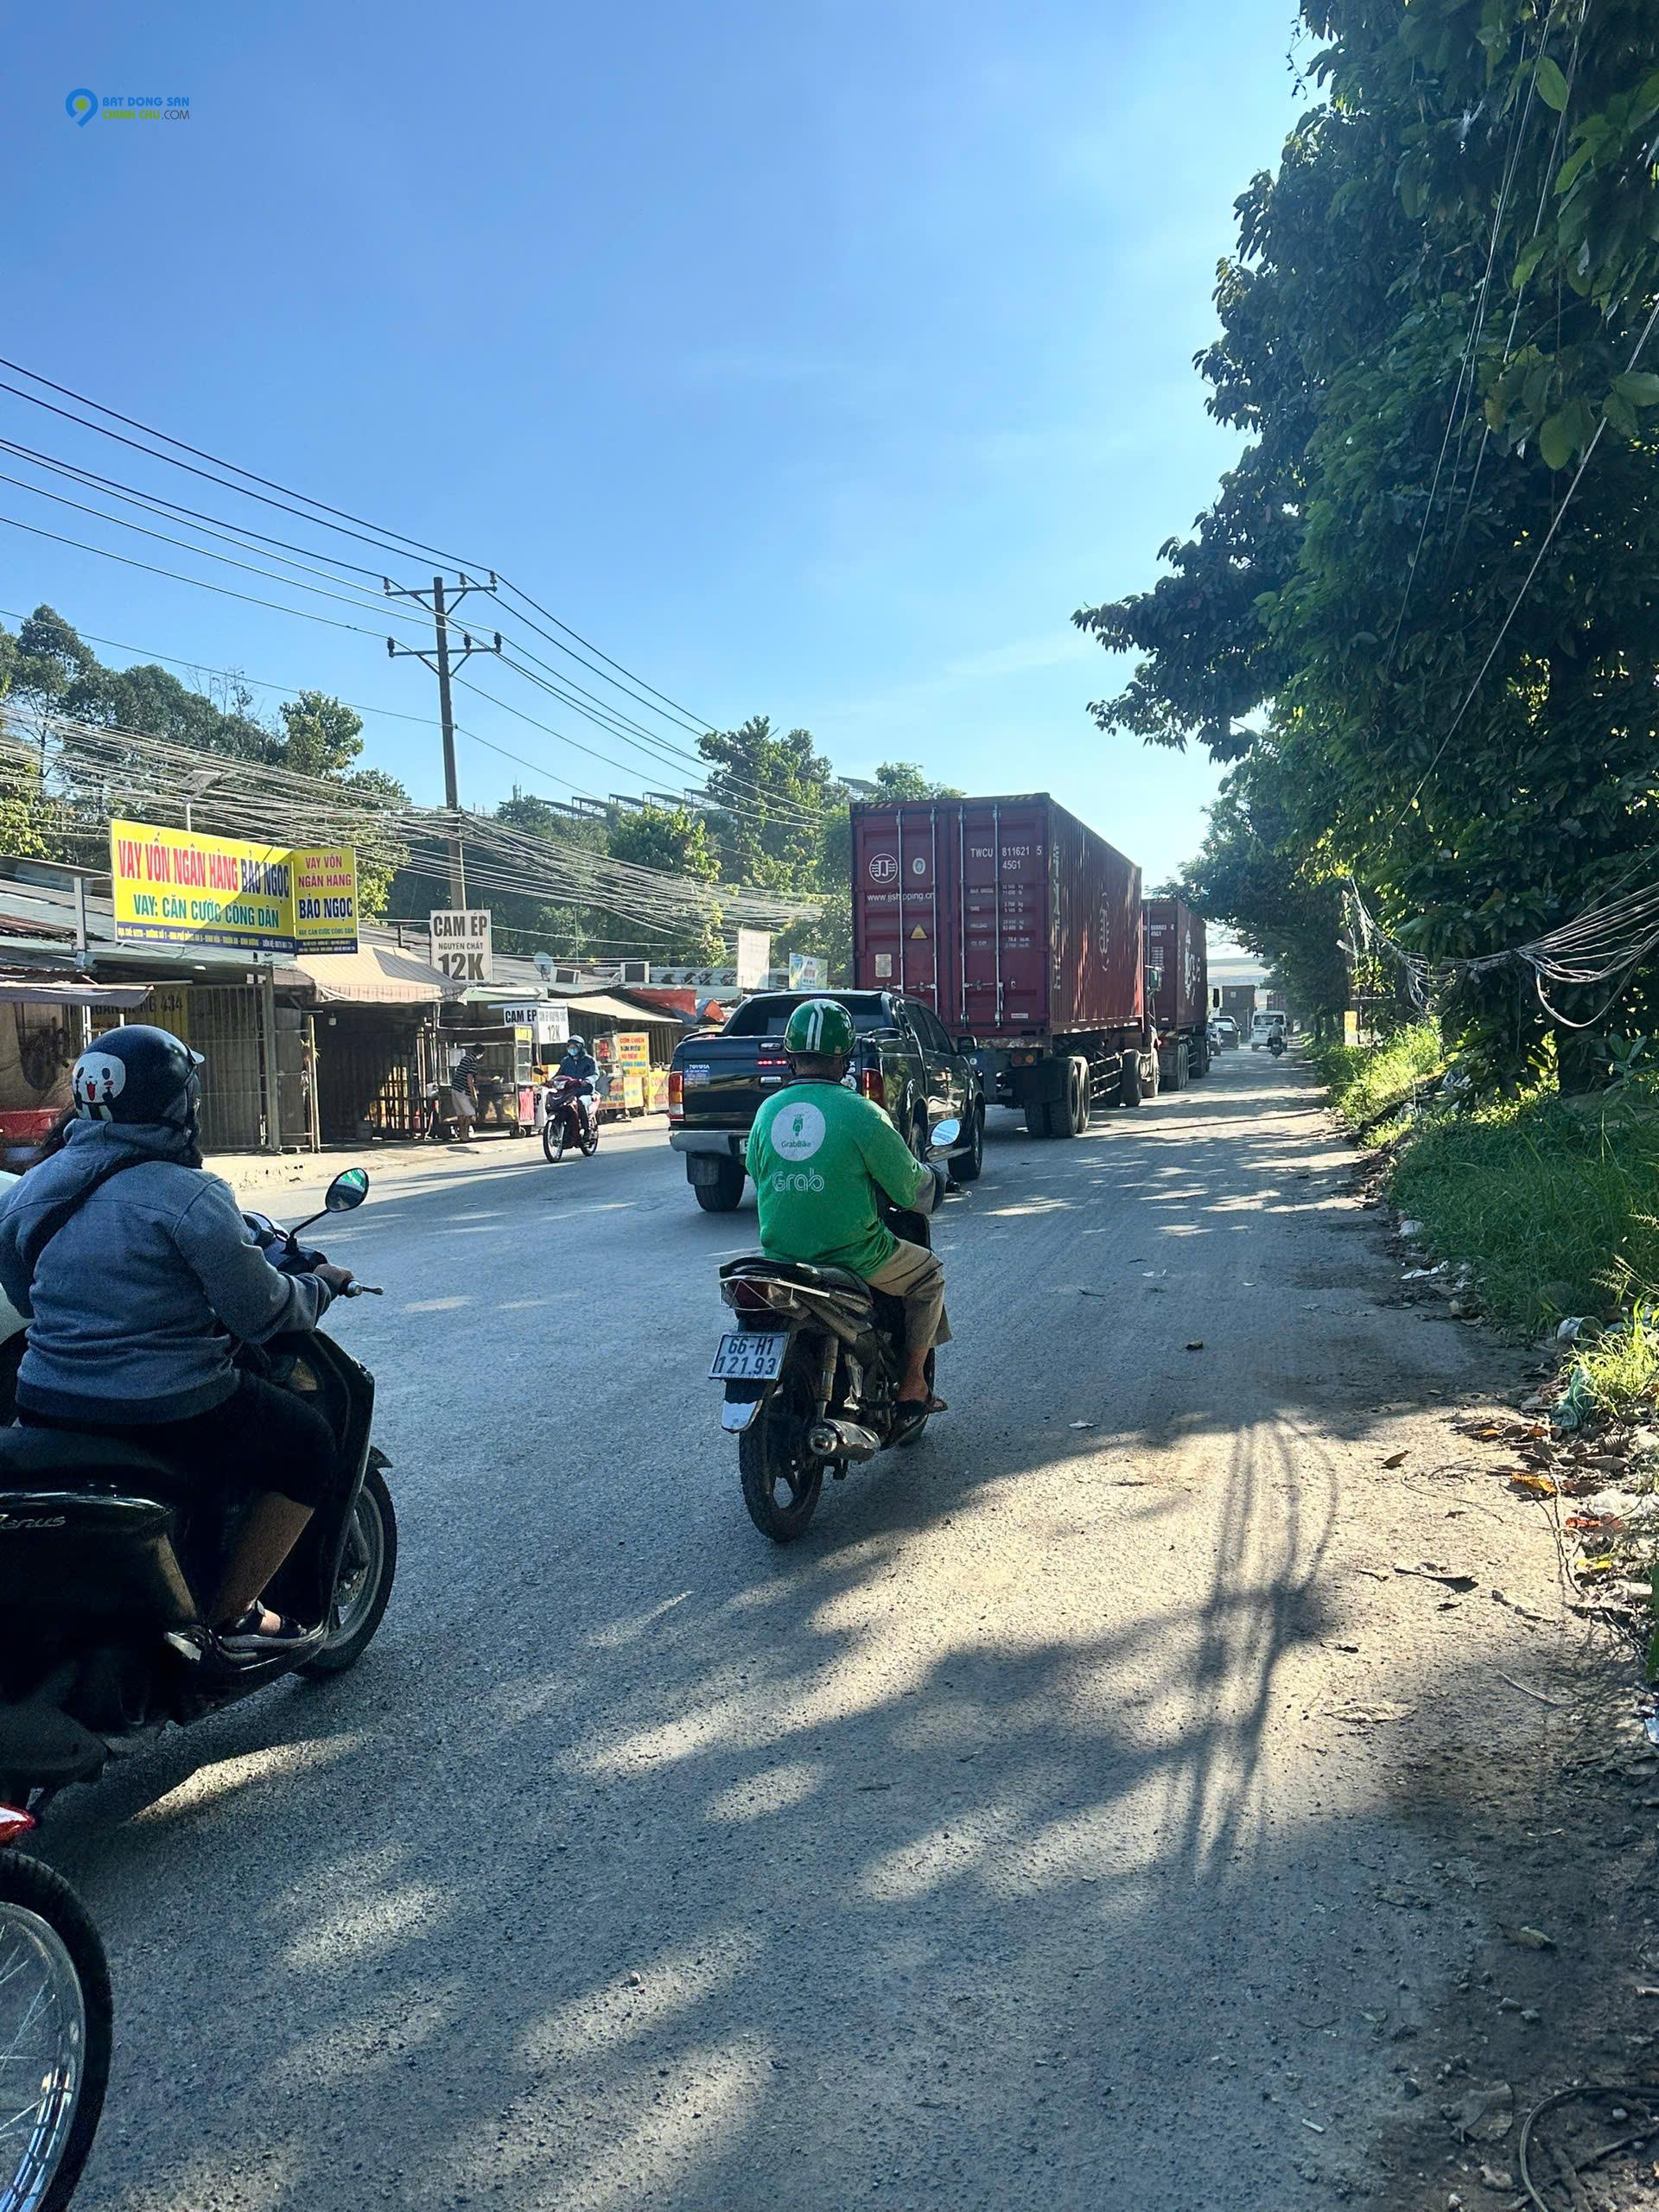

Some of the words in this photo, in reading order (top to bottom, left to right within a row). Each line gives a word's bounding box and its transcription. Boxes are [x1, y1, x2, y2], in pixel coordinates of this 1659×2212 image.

[970, 848, 994, 858] TWCU
[1002, 846, 1030, 857] 811621
[1037, 845, 1042, 855] 5
[118, 840, 142, 879] VAY
[145, 831, 170, 882] VỐN
[173, 843, 206, 887] NGÂN
[209, 849, 238, 891] HÀNG
[241, 850, 260, 894] BẢO
[264, 862, 289, 904] NGỌC
[305, 857, 321, 869] VAY
[1002, 860, 1020, 869] 45G1
[298, 873, 323, 887] NGÂN
[134, 893, 158, 917] VAY:
[162, 894, 187, 918] CĂN
[191, 898, 221, 923] CƯỚC
[226, 901, 254, 925] CÔNG
[258, 905, 279, 928] DÂN
[299, 893, 321, 919] BẢO
[323, 898, 353, 921] NGỌC
[434, 916, 465, 937] CAM
[471, 912, 487, 937] ÉP
[438, 953, 484, 981] 12K
[505, 1010, 524, 1023] CAM
[548, 1025, 561, 1042] 12K
[781, 1140, 811, 1148] GrabBike
[772, 1167, 824, 1192] Grab
[728, 1338, 774, 1356] 66-H1
[718, 1356, 777, 1376] 121.93
